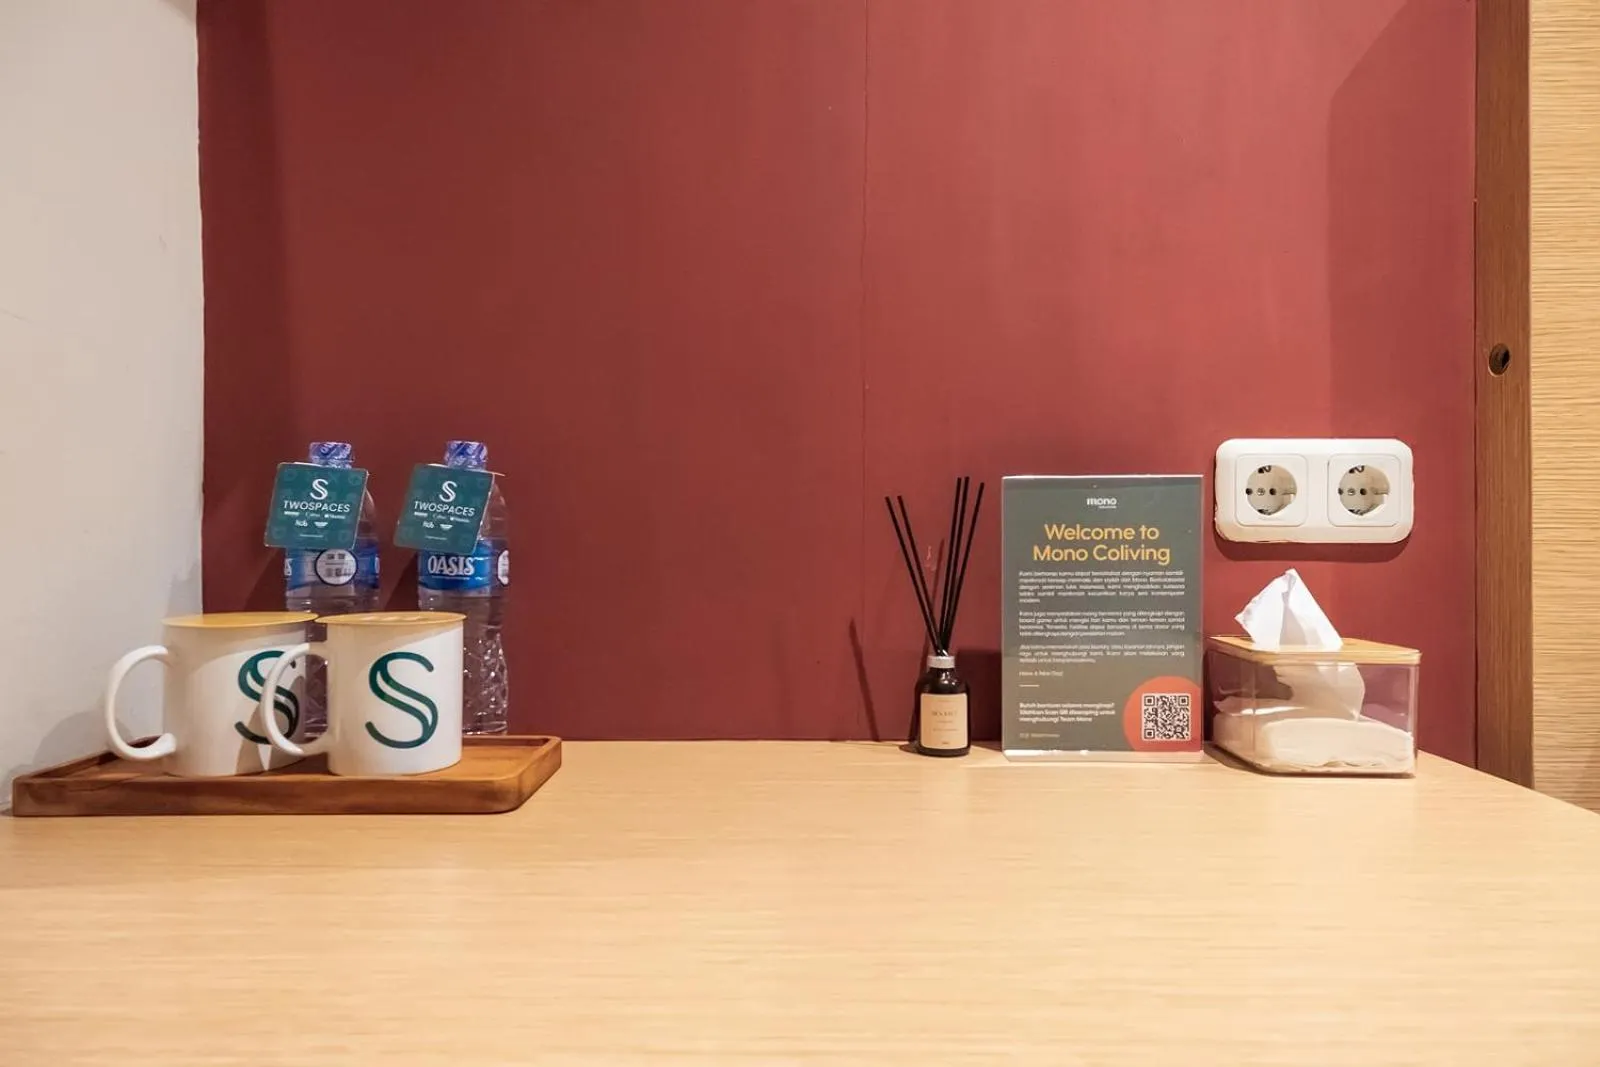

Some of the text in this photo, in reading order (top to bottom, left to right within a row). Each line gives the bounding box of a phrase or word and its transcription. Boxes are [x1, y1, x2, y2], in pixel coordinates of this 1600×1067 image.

[283, 500, 351, 513] TWOSPACES
[414, 501, 476, 517] TWOSPACES
[1044, 524, 1160, 541] Welcome to
[1033, 545, 1170, 566] Mono Coliving
[427, 555, 475, 576] OASIS
